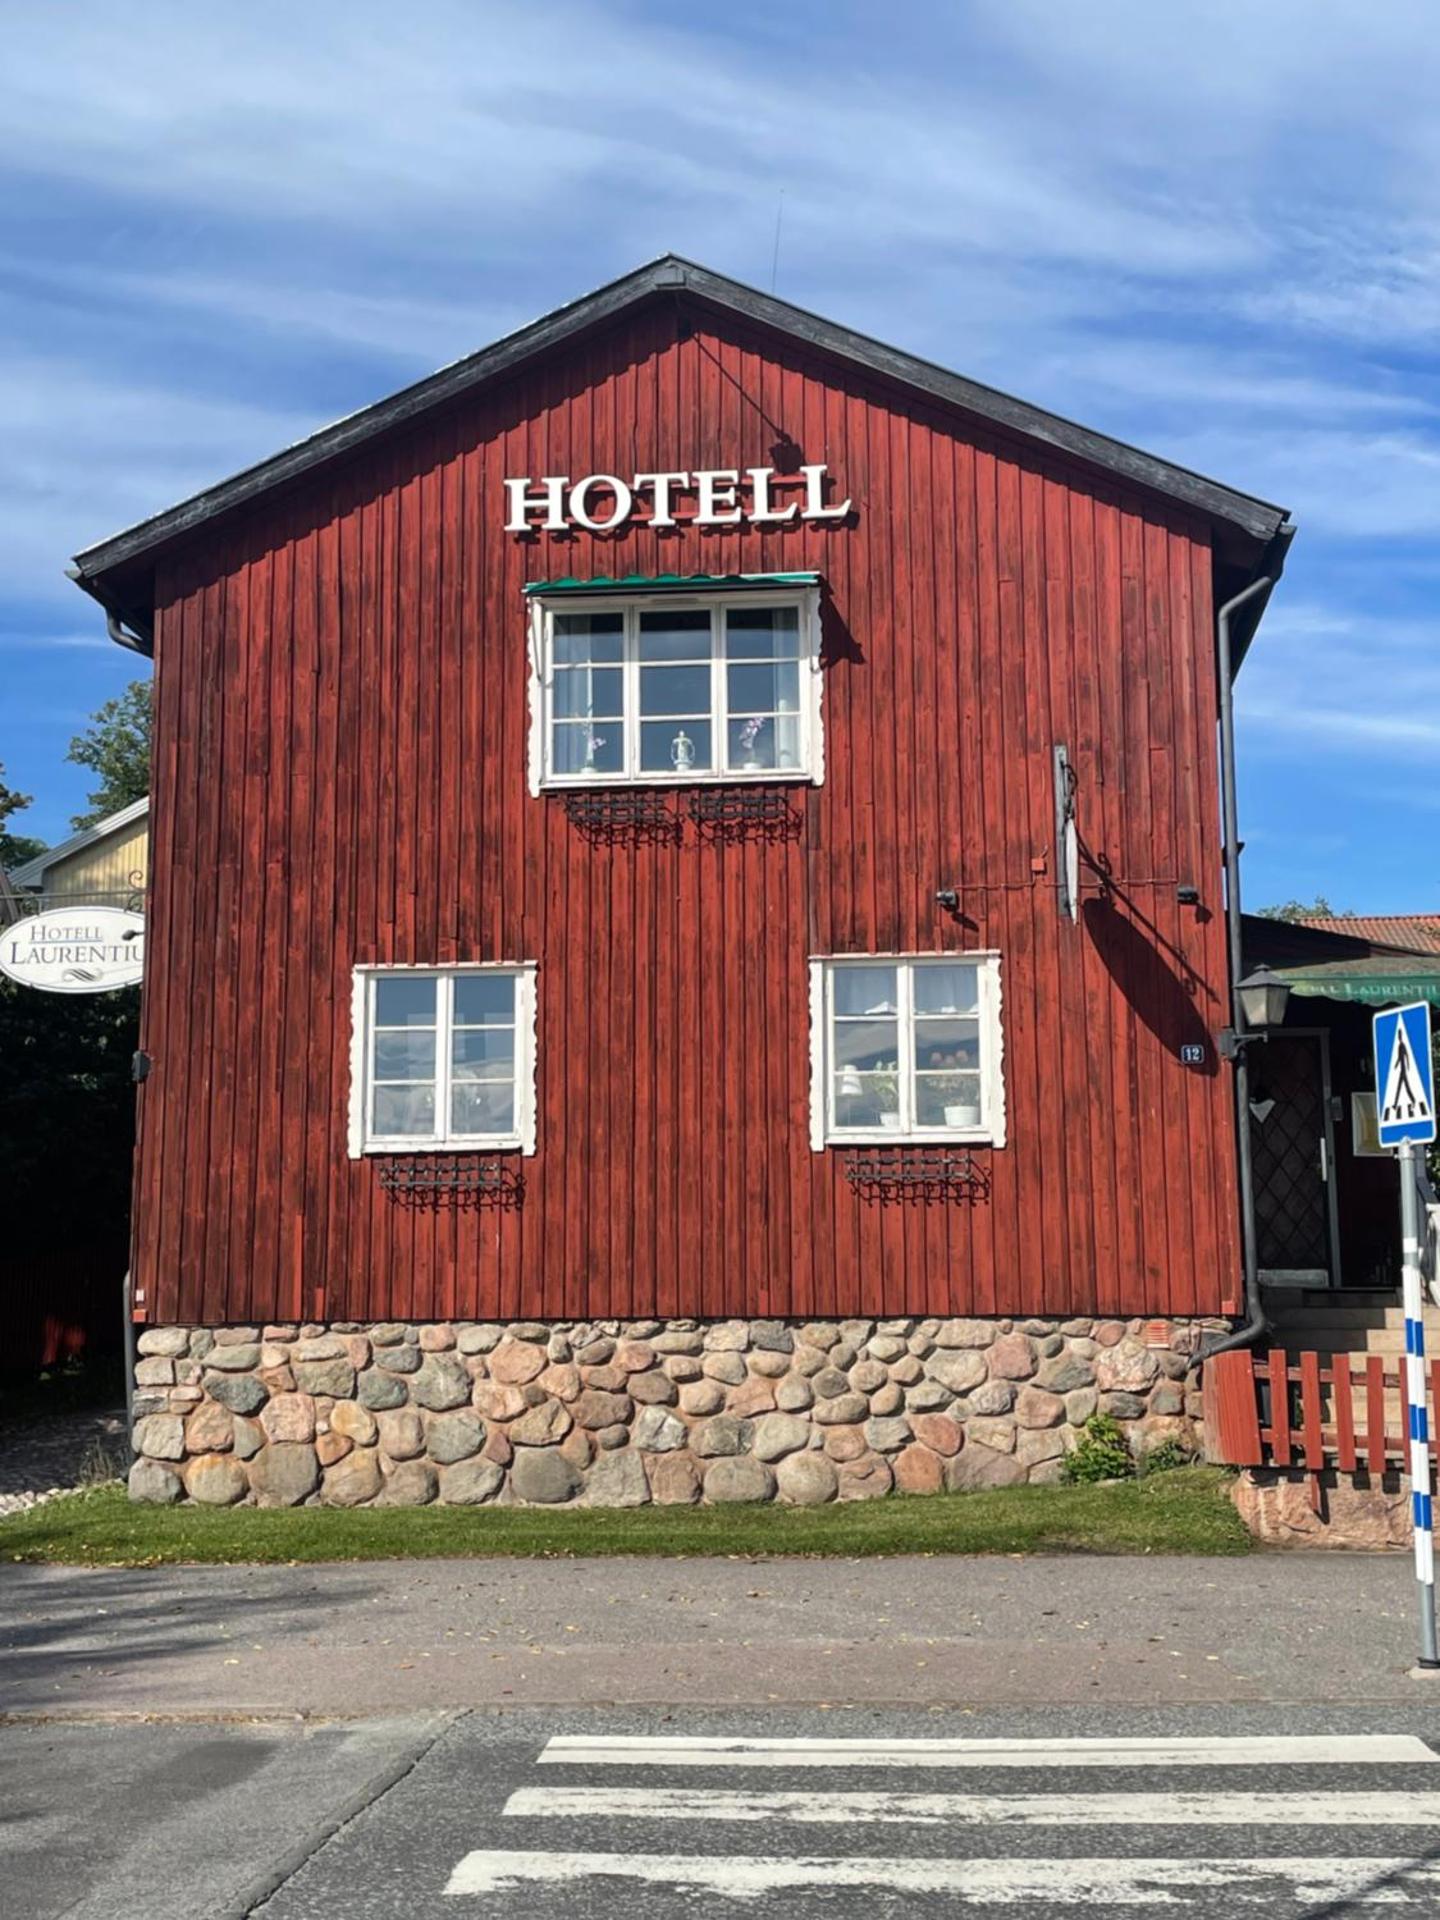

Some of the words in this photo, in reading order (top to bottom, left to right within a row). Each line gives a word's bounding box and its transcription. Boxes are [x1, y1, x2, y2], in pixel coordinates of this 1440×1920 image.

[503, 464, 852, 532] HOTELL
[30, 925, 103, 941] HOTELL
[1185, 1047, 1201, 1060] 12
